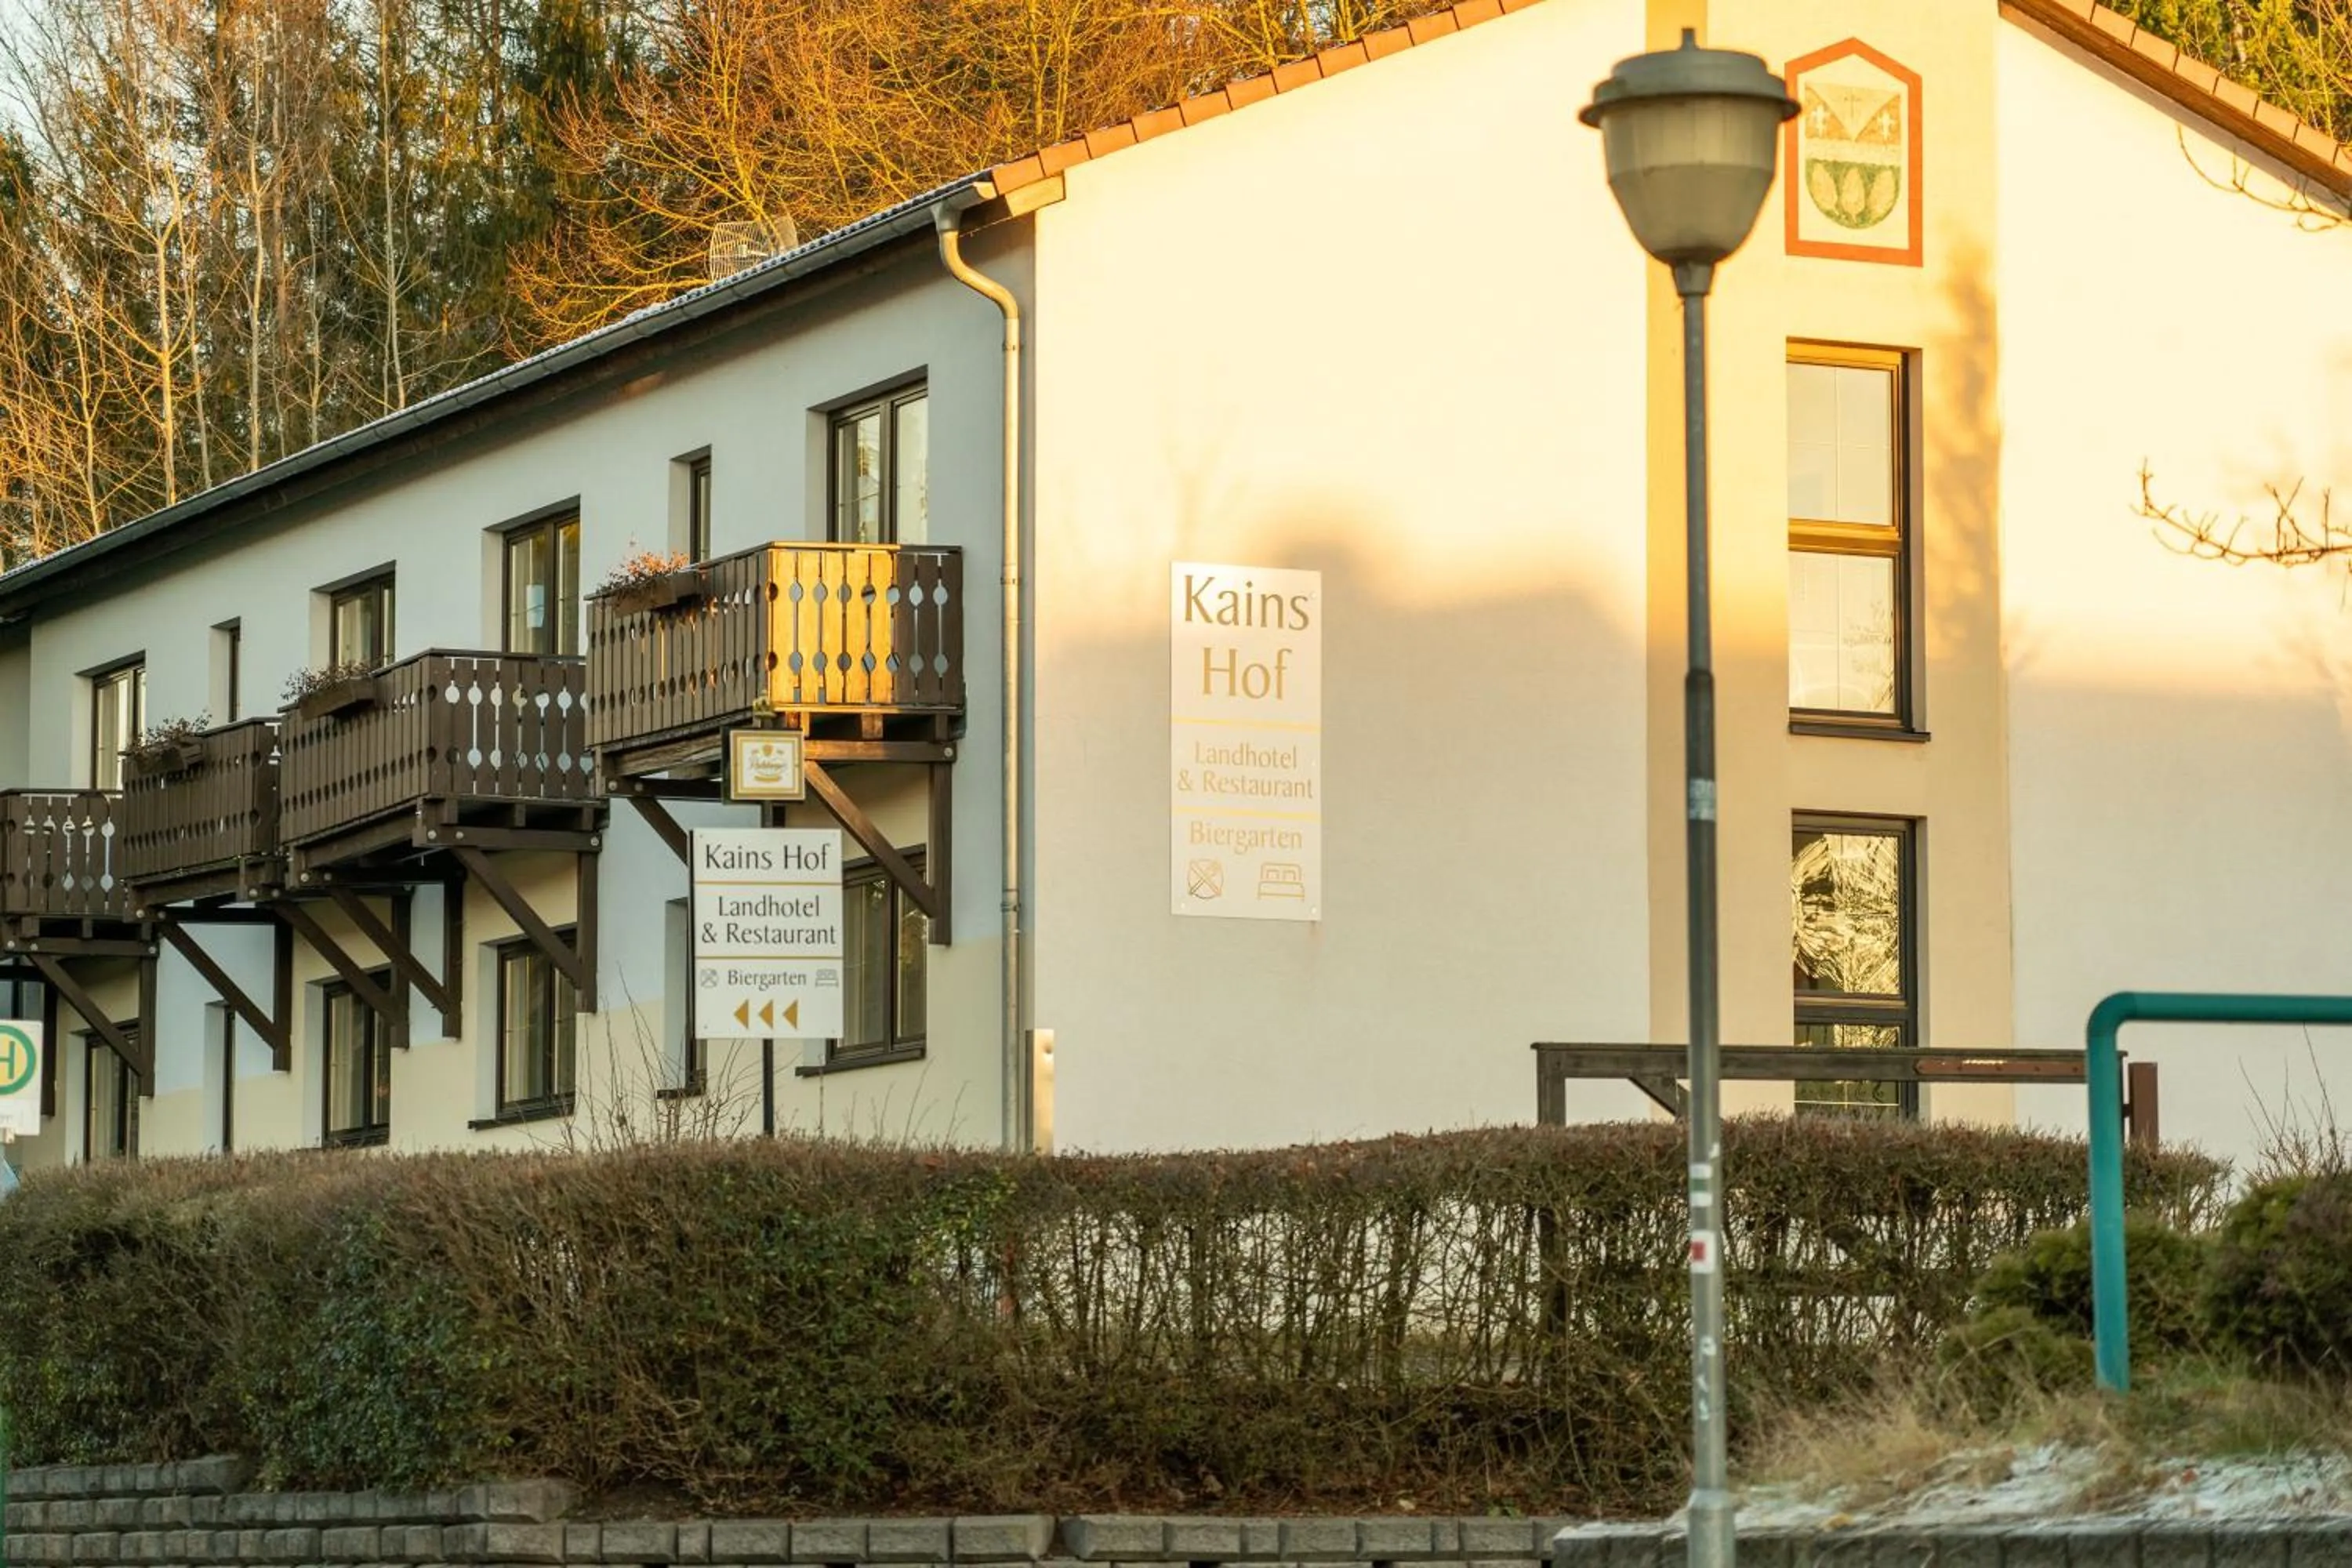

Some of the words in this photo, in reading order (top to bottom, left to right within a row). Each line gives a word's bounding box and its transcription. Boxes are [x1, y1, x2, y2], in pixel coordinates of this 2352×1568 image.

[1185, 575, 1309, 630] Kains
[1202, 647, 1293, 700] Hof
[1195, 741, 1298, 770] Landhotel
[1178, 769, 1192, 791] &
[1203, 770, 1313, 799] Restaurant
[1189, 821, 1303, 855] Biergarten
[706, 844, 773, 870] Kains
[784, 843, 831, 870] Hof
[718, 895, 820, 917] Landhotel
[702, 922, 718, 944] &
[726, 923, 837, 945] Restaurant
[728, 970, 807, 991] Biergarten
